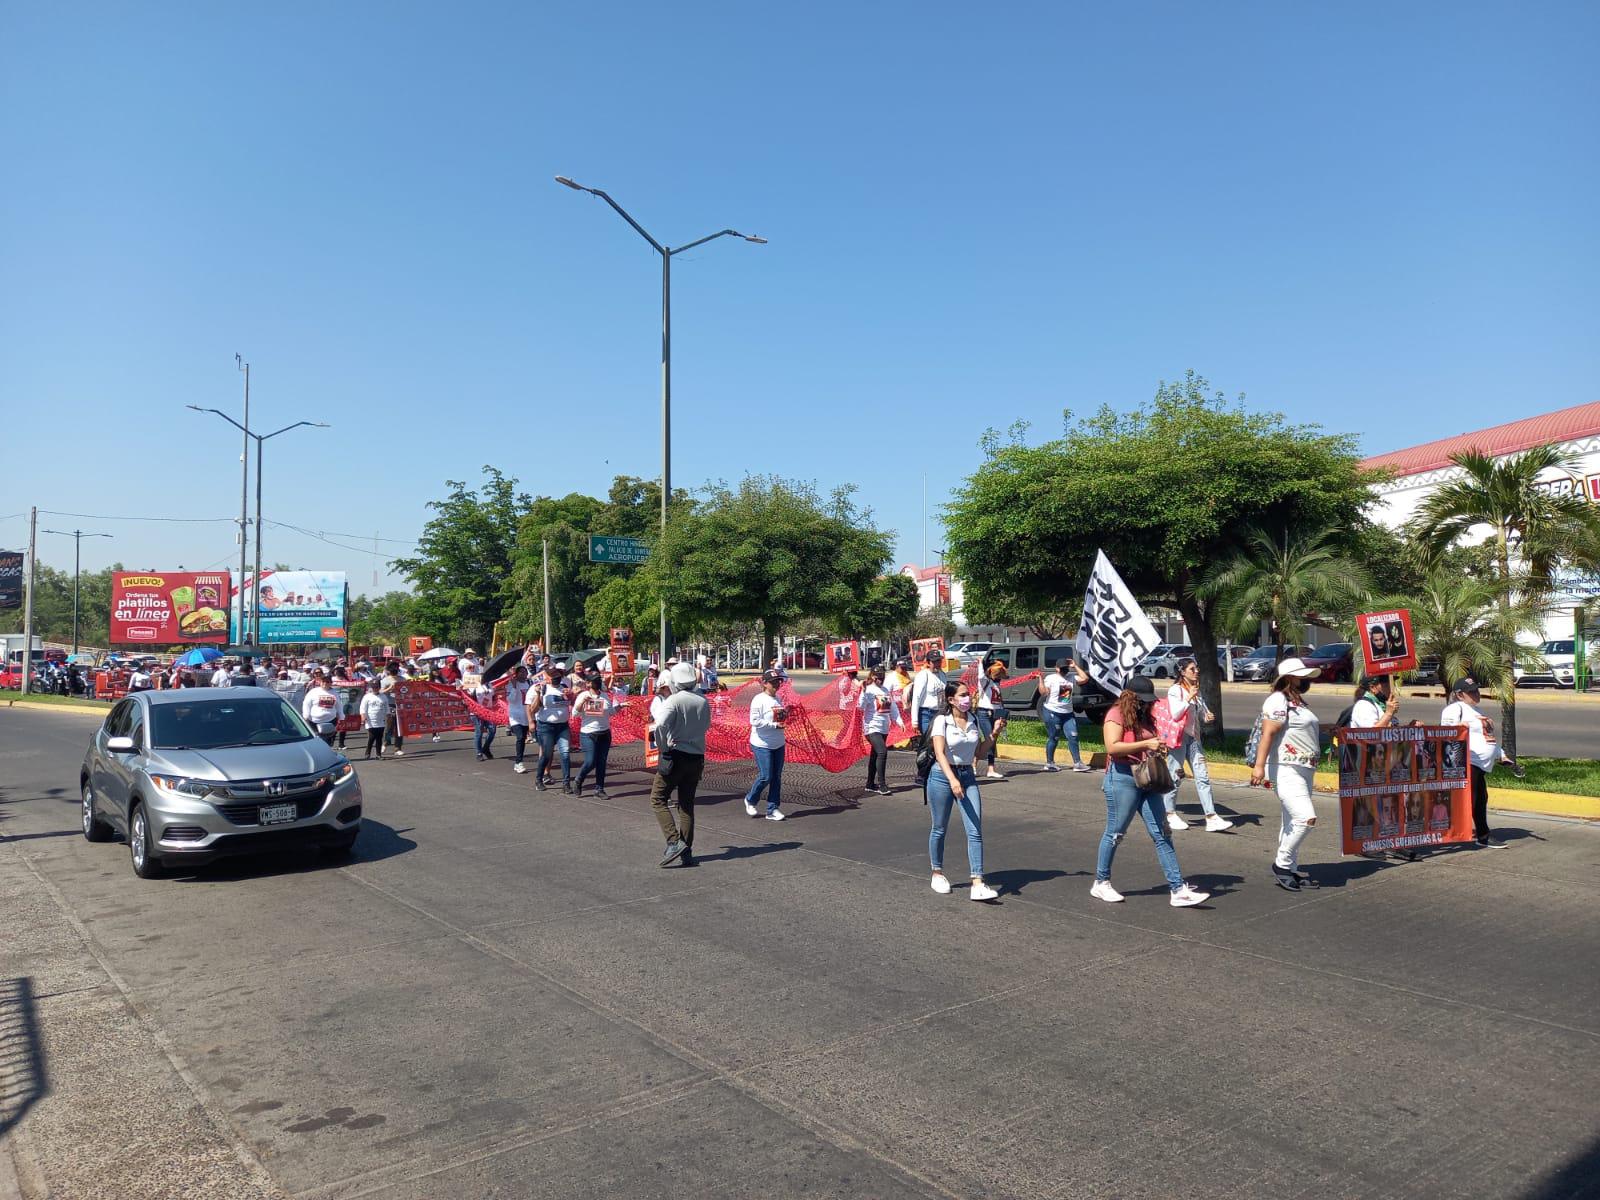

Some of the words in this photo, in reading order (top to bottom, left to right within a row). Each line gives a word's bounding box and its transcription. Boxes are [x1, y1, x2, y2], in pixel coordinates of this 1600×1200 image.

[118, 598, 167, 609] platillos
[115, 610, 131, 619] en
[136, 607, 170, 619] línea
[1381, 727, 1425, 742] JUSTICIA
